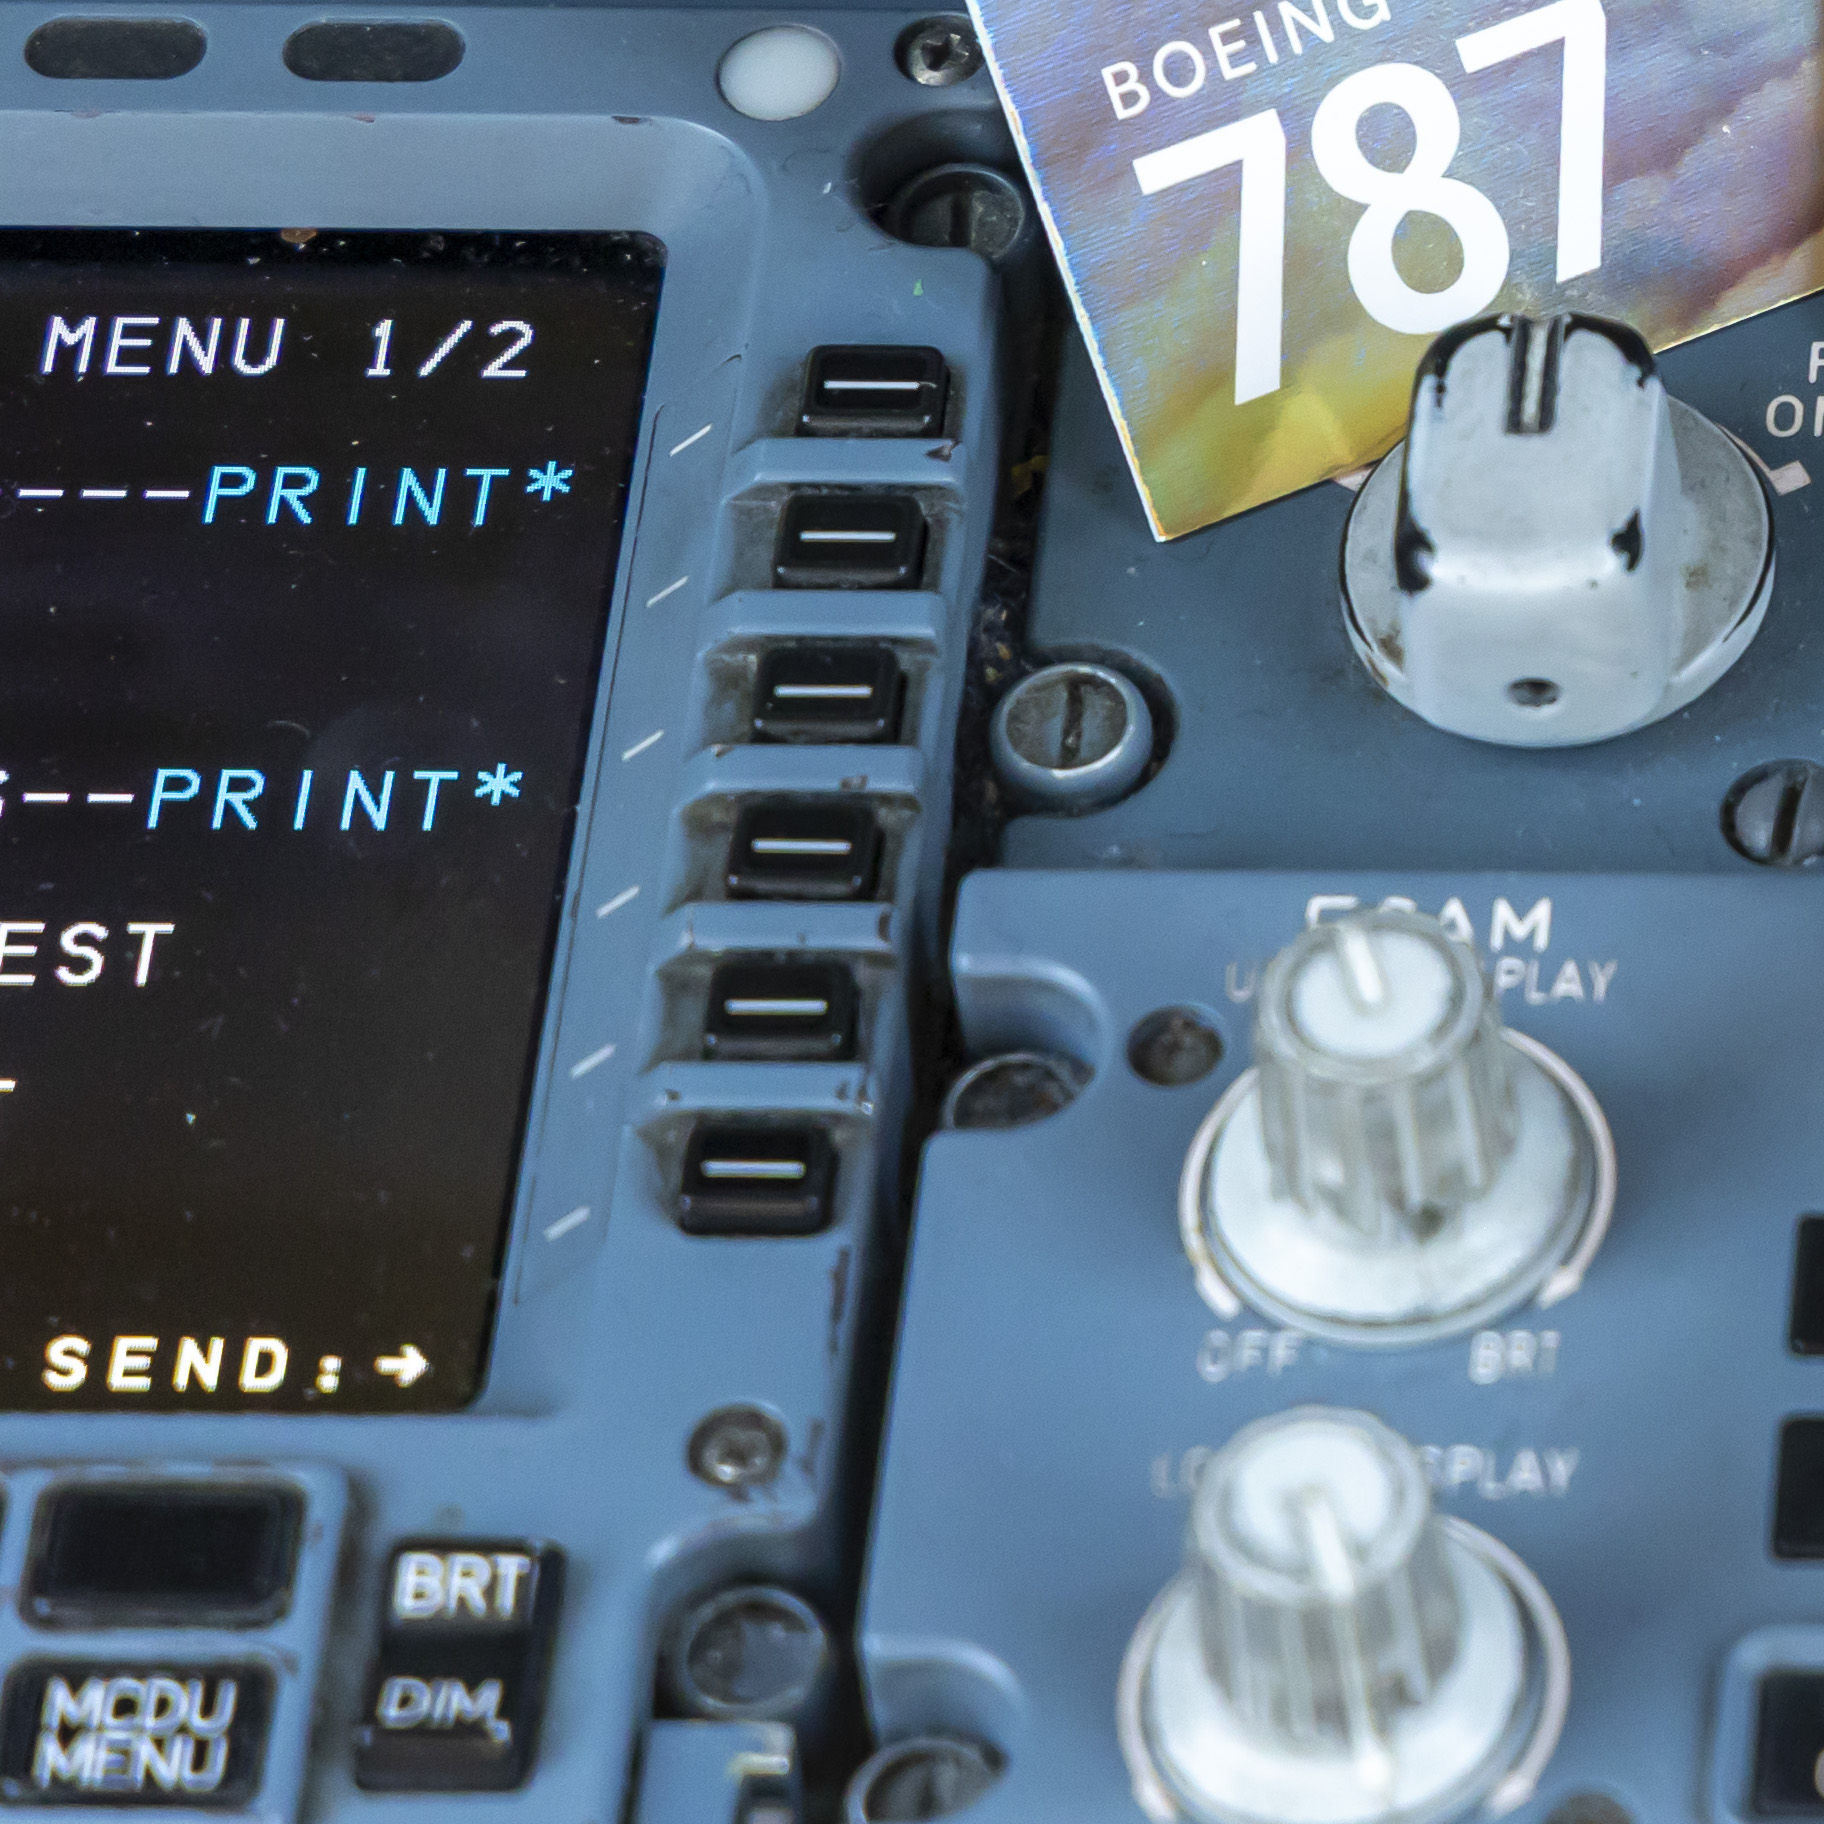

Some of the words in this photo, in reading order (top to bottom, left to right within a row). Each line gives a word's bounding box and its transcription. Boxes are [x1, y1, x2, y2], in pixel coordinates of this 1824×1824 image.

[41, 316, 285, 375] MENU
[366, 319, 535, 378] 1/2
[0, 922, 175, 987] EST
[43, 1335, 342, 1394] SEND:
[393, 1552, 532, 1619] BRT
[42, 1676, 238, 1735] MCDU
[377, 1677, 503, 1731] DIM
[34, 1730, 229, 1791] MENU
